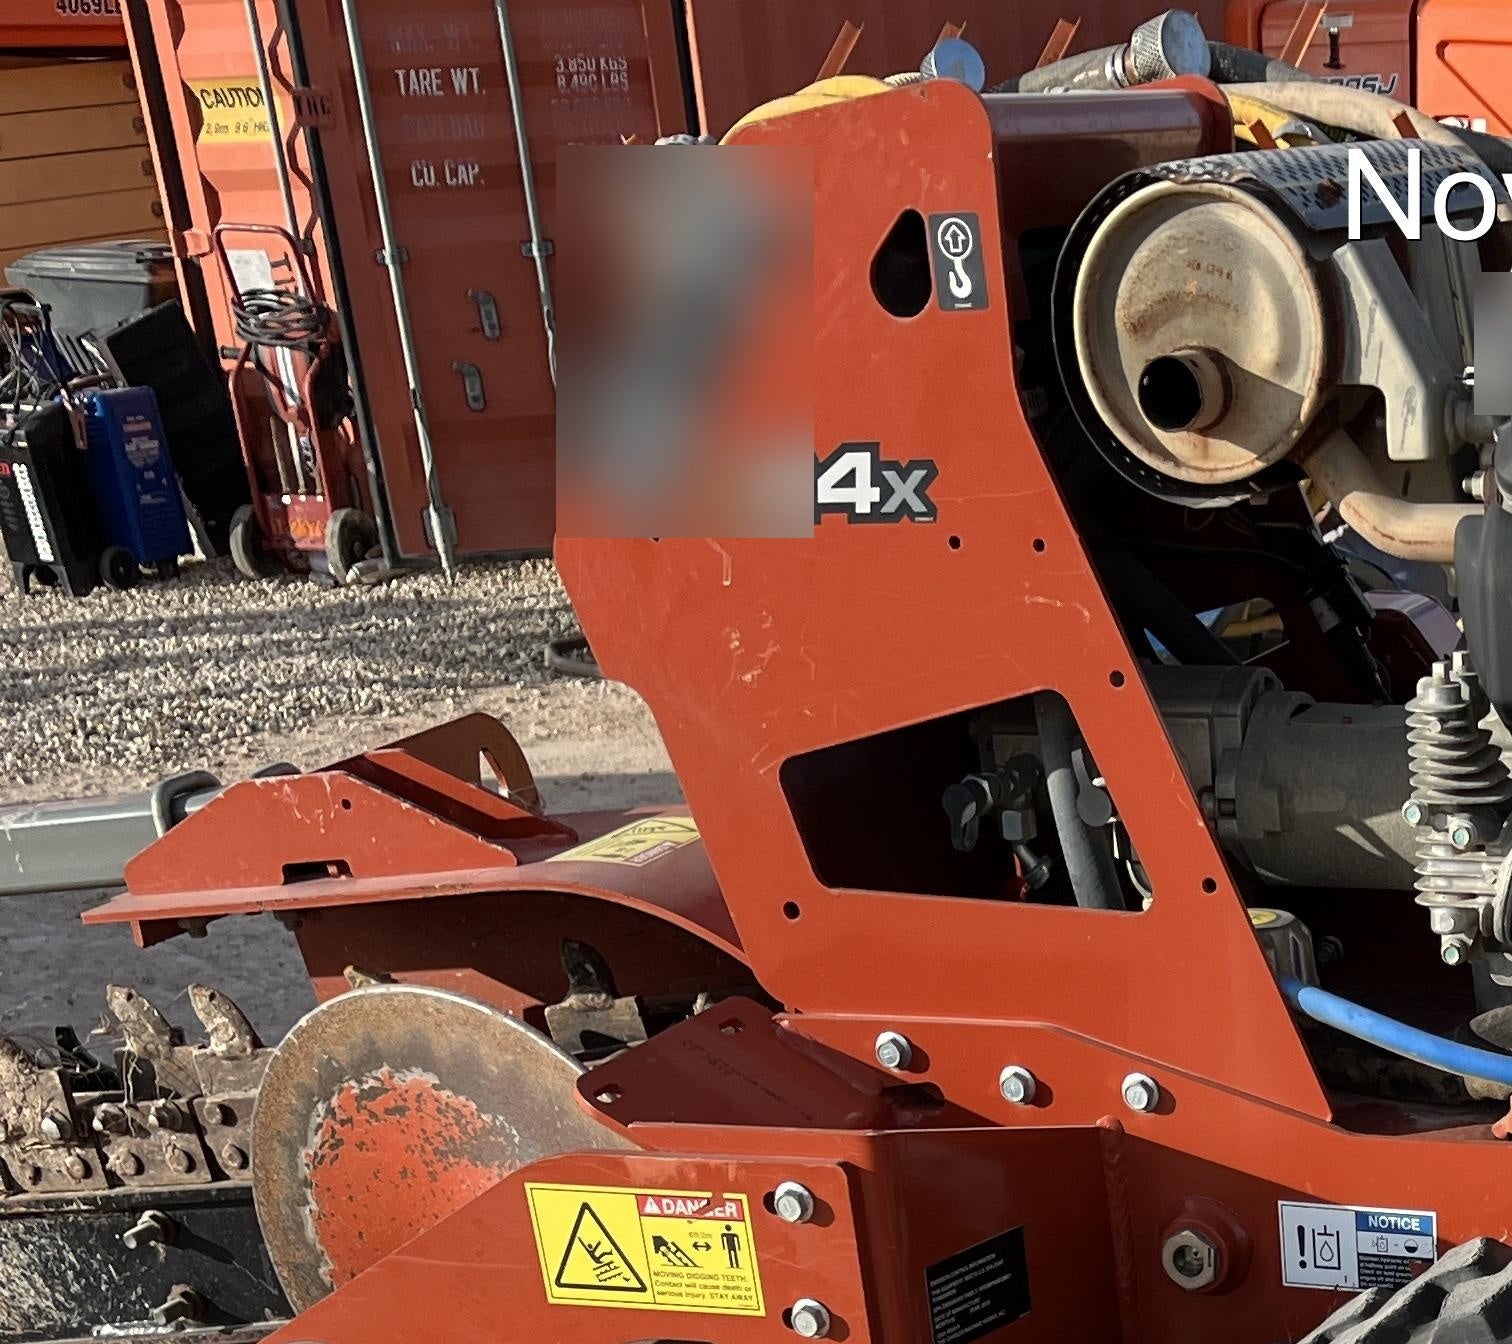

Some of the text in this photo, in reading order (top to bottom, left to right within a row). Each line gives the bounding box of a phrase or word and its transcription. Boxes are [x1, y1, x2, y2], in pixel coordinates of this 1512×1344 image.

[395, 68, 486, 96] TARE WT.
[445, 161, 485, 187] CAP.
[1368, 1215, 1421, 1231] NOTICE
